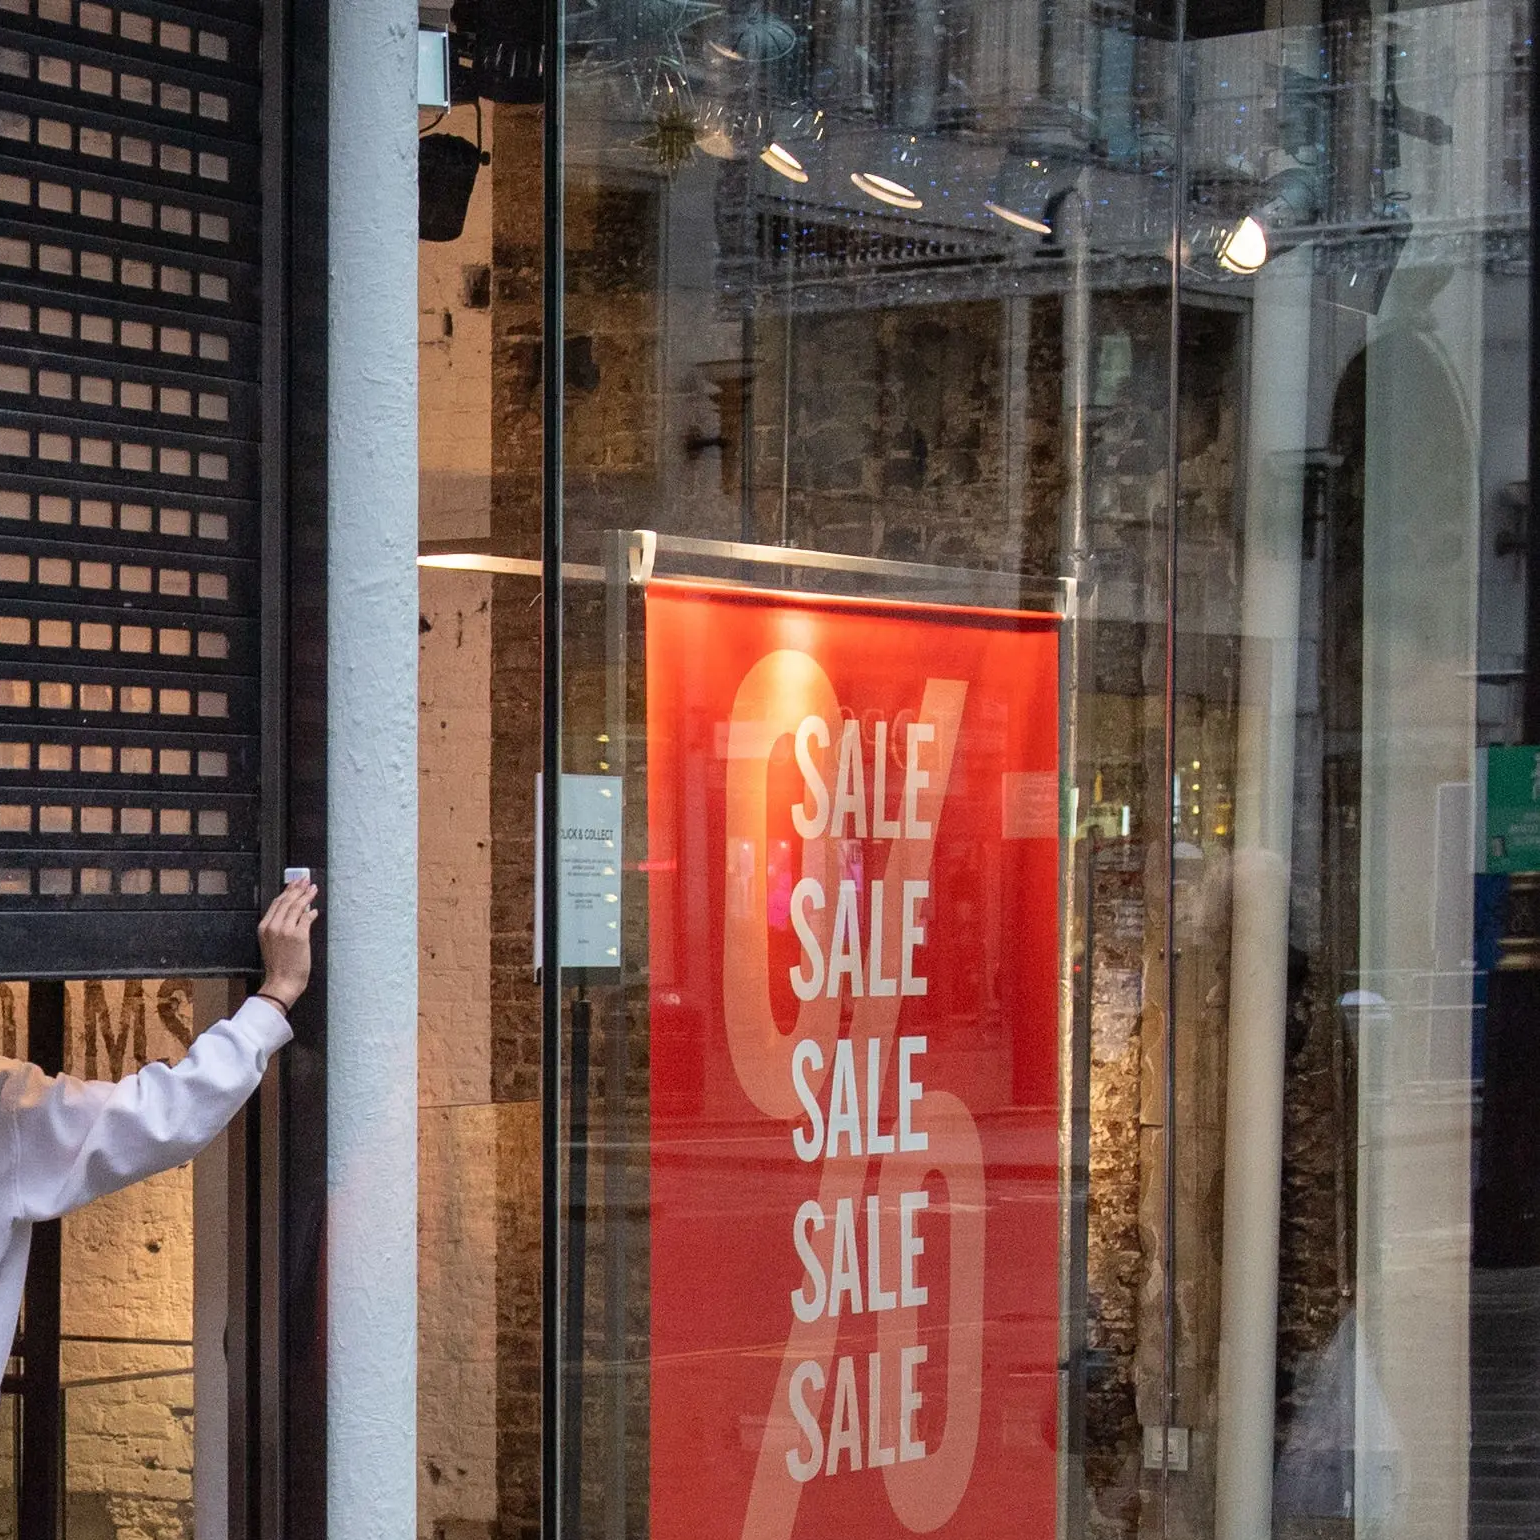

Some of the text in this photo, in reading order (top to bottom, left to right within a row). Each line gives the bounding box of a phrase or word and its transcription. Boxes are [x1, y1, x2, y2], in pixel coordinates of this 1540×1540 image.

[791, 715, 935, 839] SALE
[788, 877, 929, 1001] SALE
[790, 1036, 929, 1162] SALE
[790, 1191, 929, 1323] SALE
[785, 1345, 926, 1483] SALE
